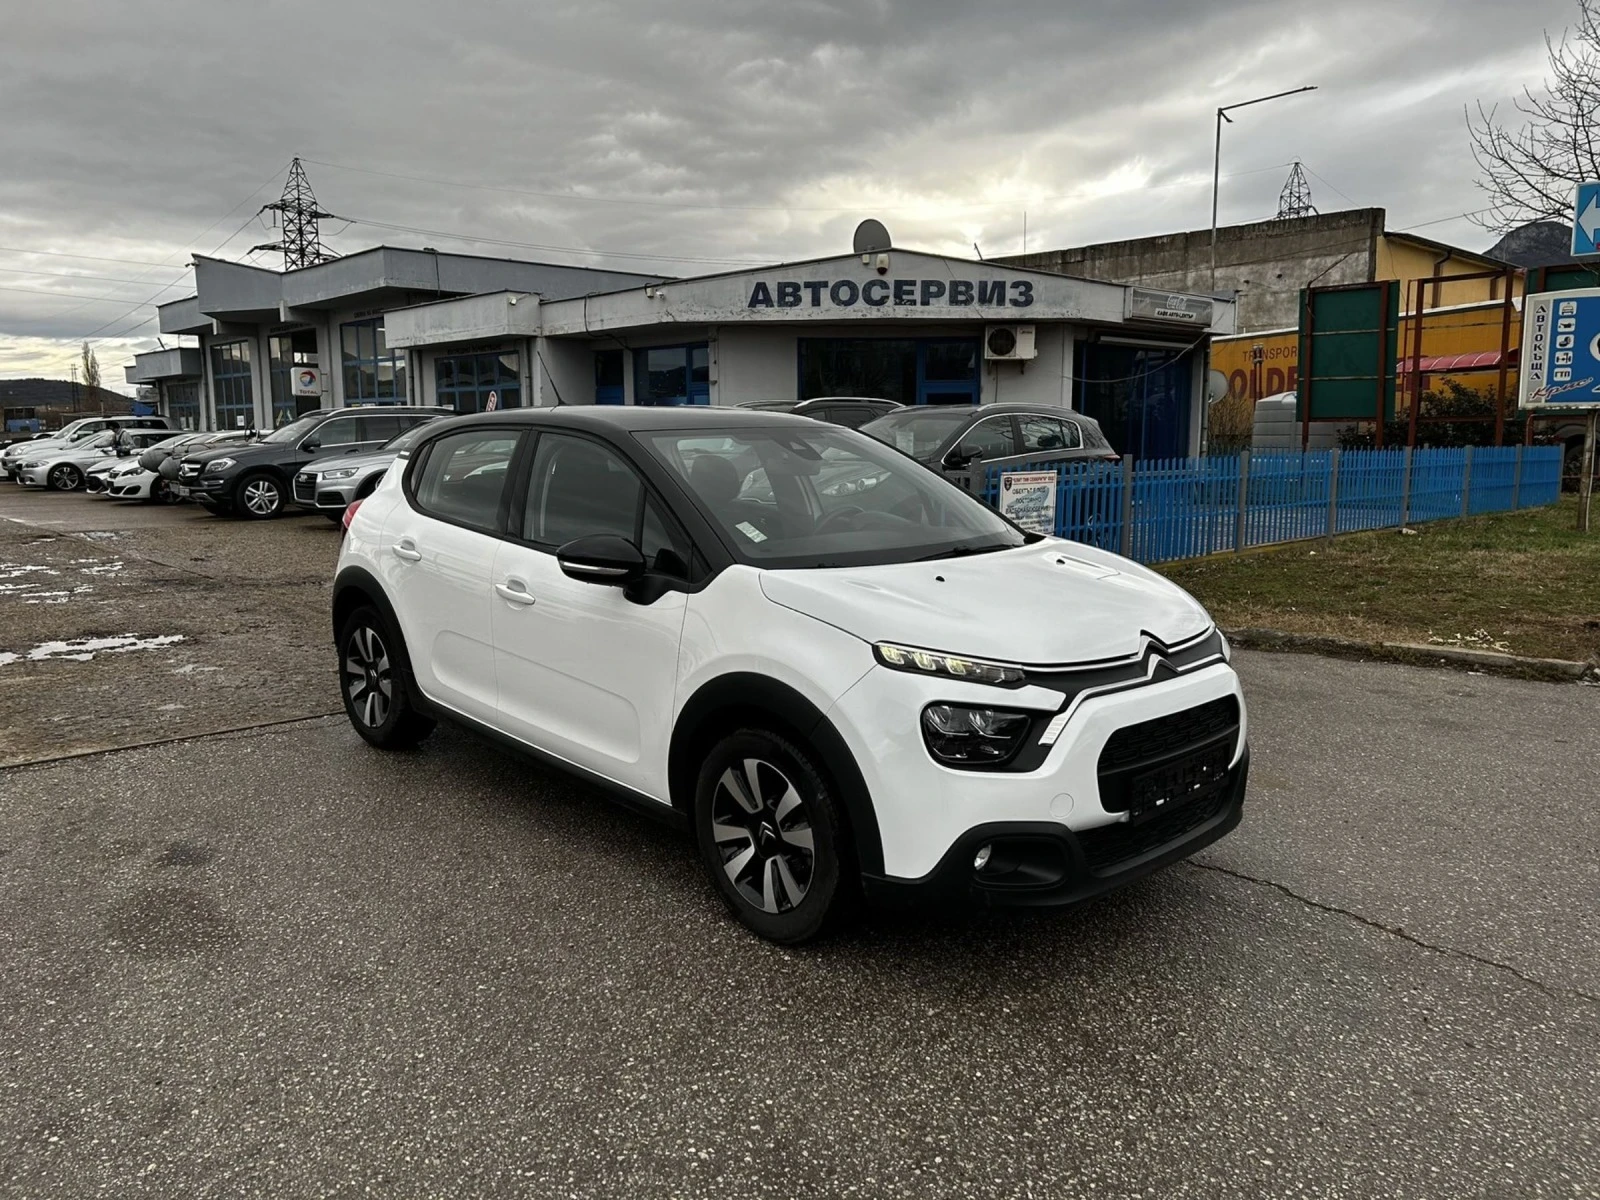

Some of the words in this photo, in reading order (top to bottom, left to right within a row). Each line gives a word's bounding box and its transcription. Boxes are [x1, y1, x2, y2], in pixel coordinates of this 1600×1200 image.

[747, 279, 1034, 308] АВТОСЕРВИЗ
[1243, 346, 1297, 361] TRNSPOR
[1531, 305, 1547, 380] АВТОКЪЩА
